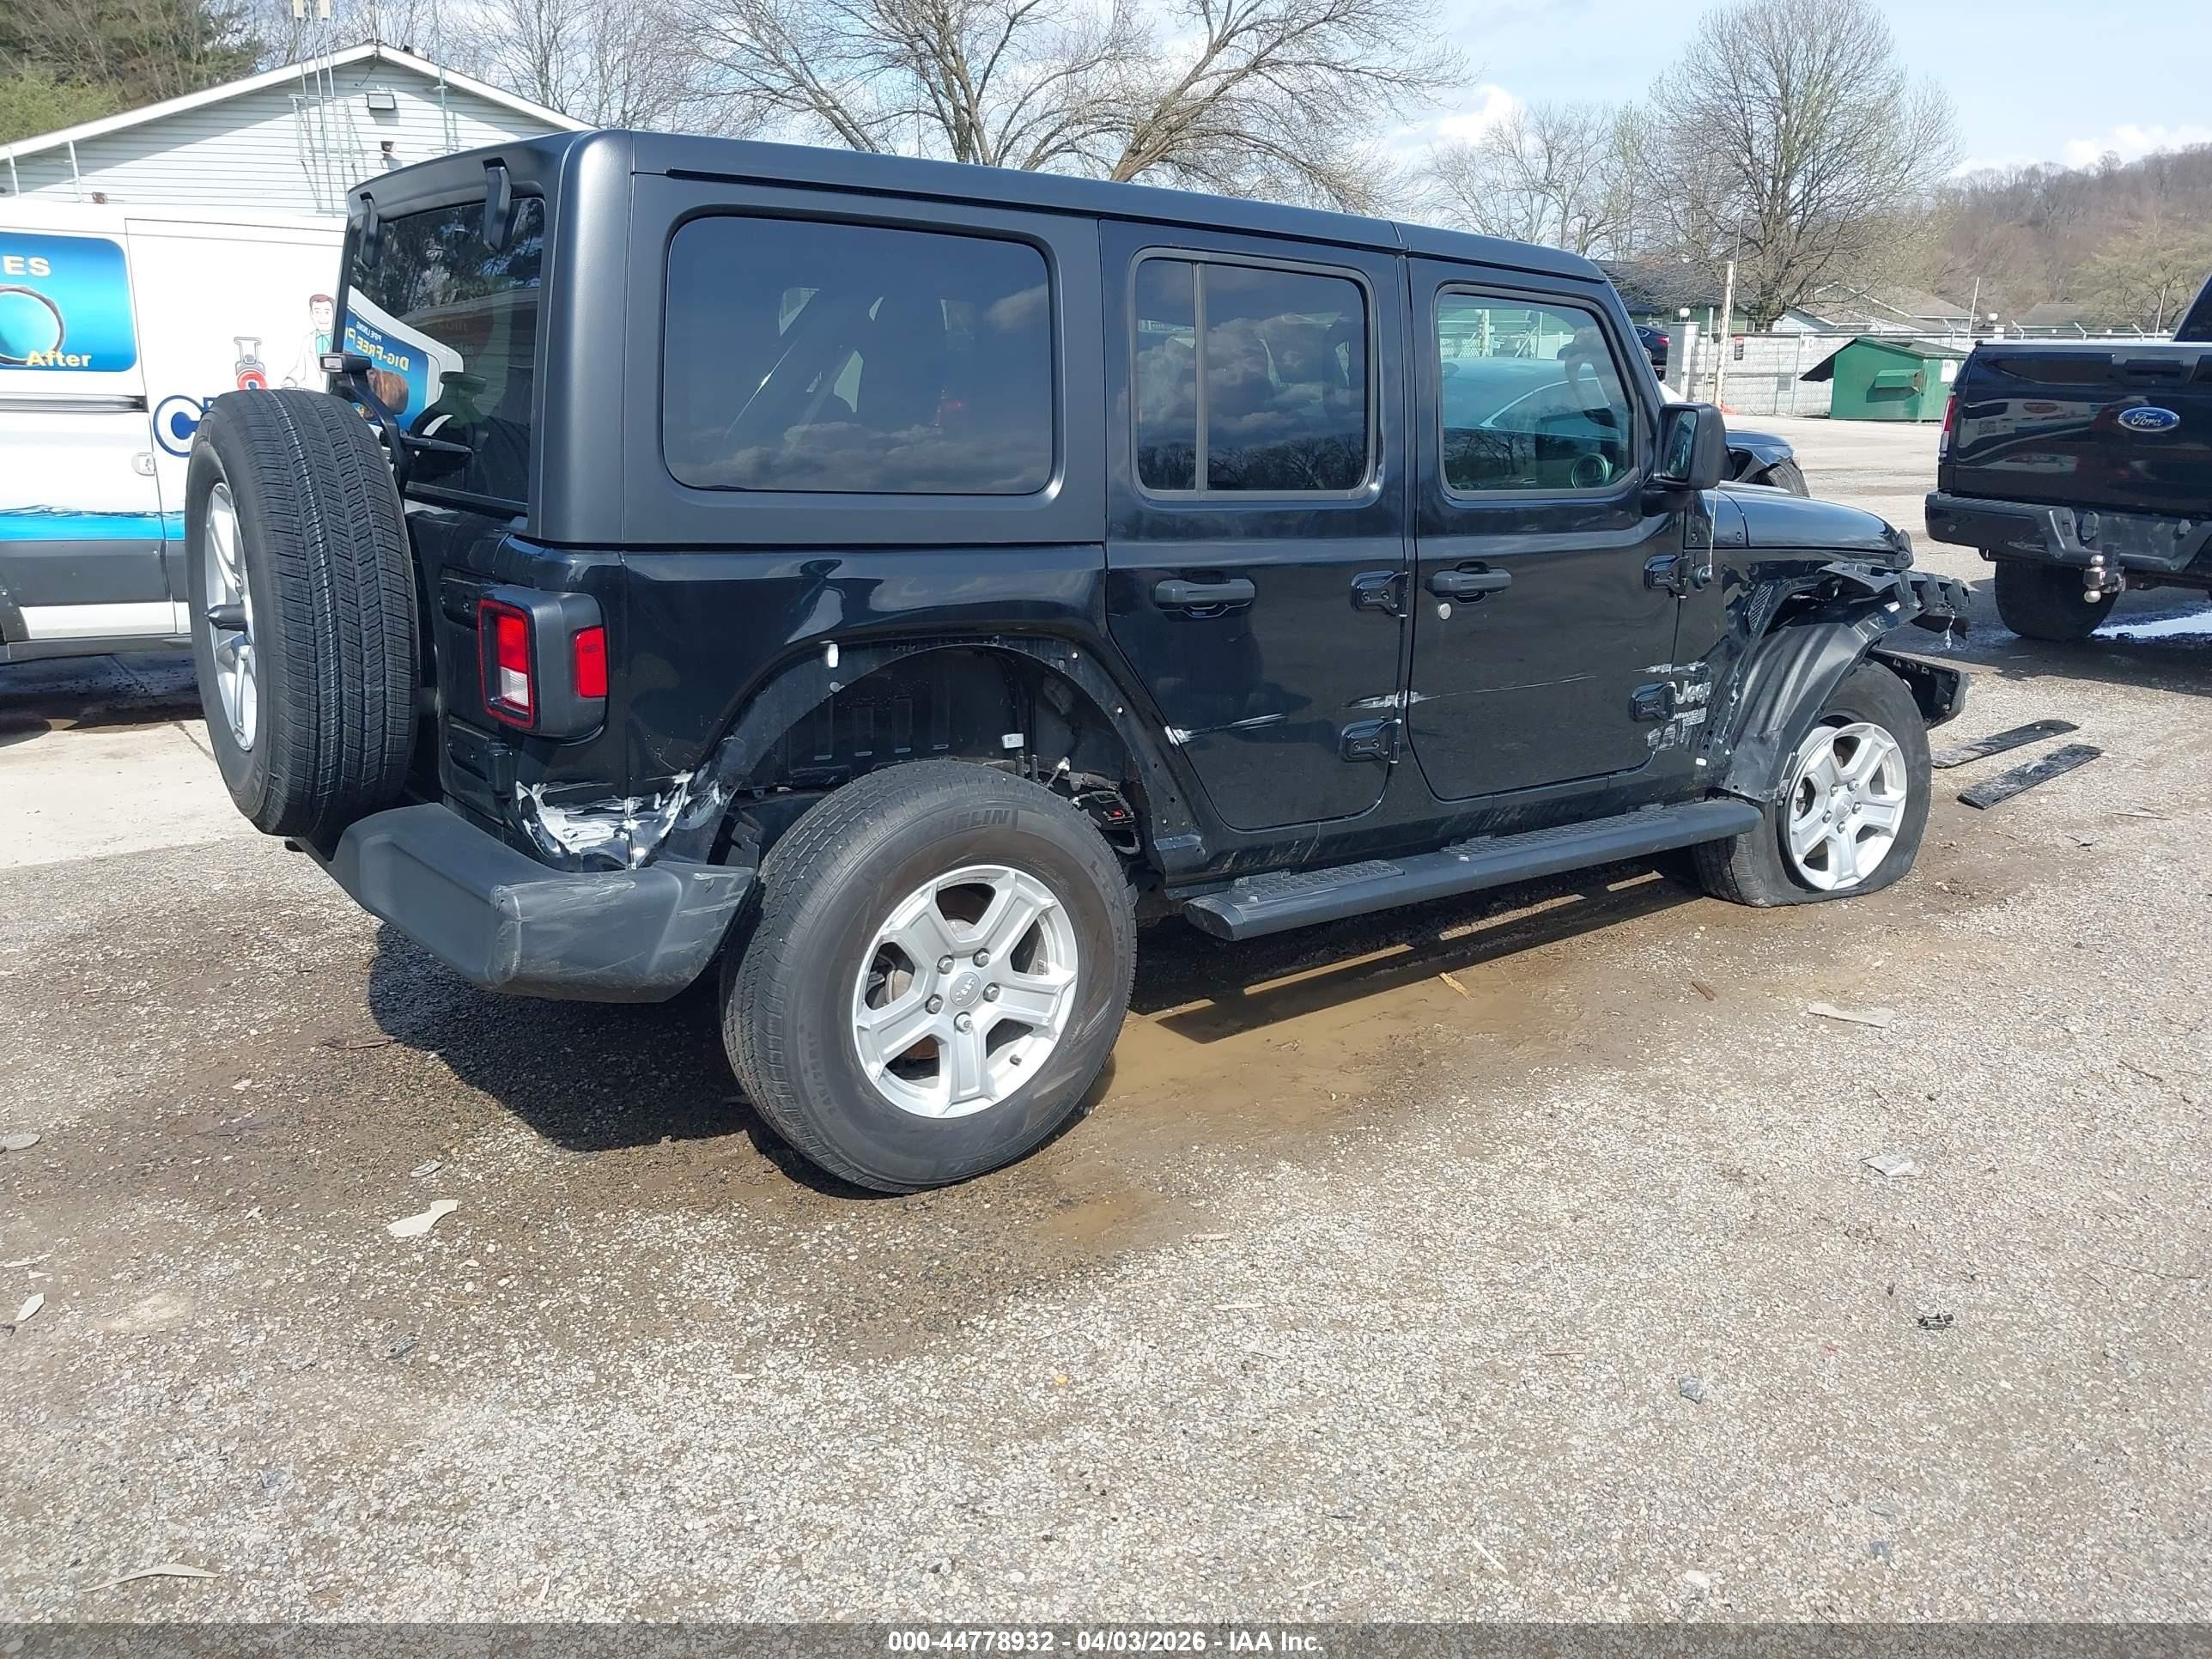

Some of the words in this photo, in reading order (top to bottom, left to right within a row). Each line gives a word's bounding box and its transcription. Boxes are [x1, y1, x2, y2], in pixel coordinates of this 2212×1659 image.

[2, 254, 52, 277] ES
[26, 349, 93, 368] After
[1674, 679, 1713, 705] Jeep
